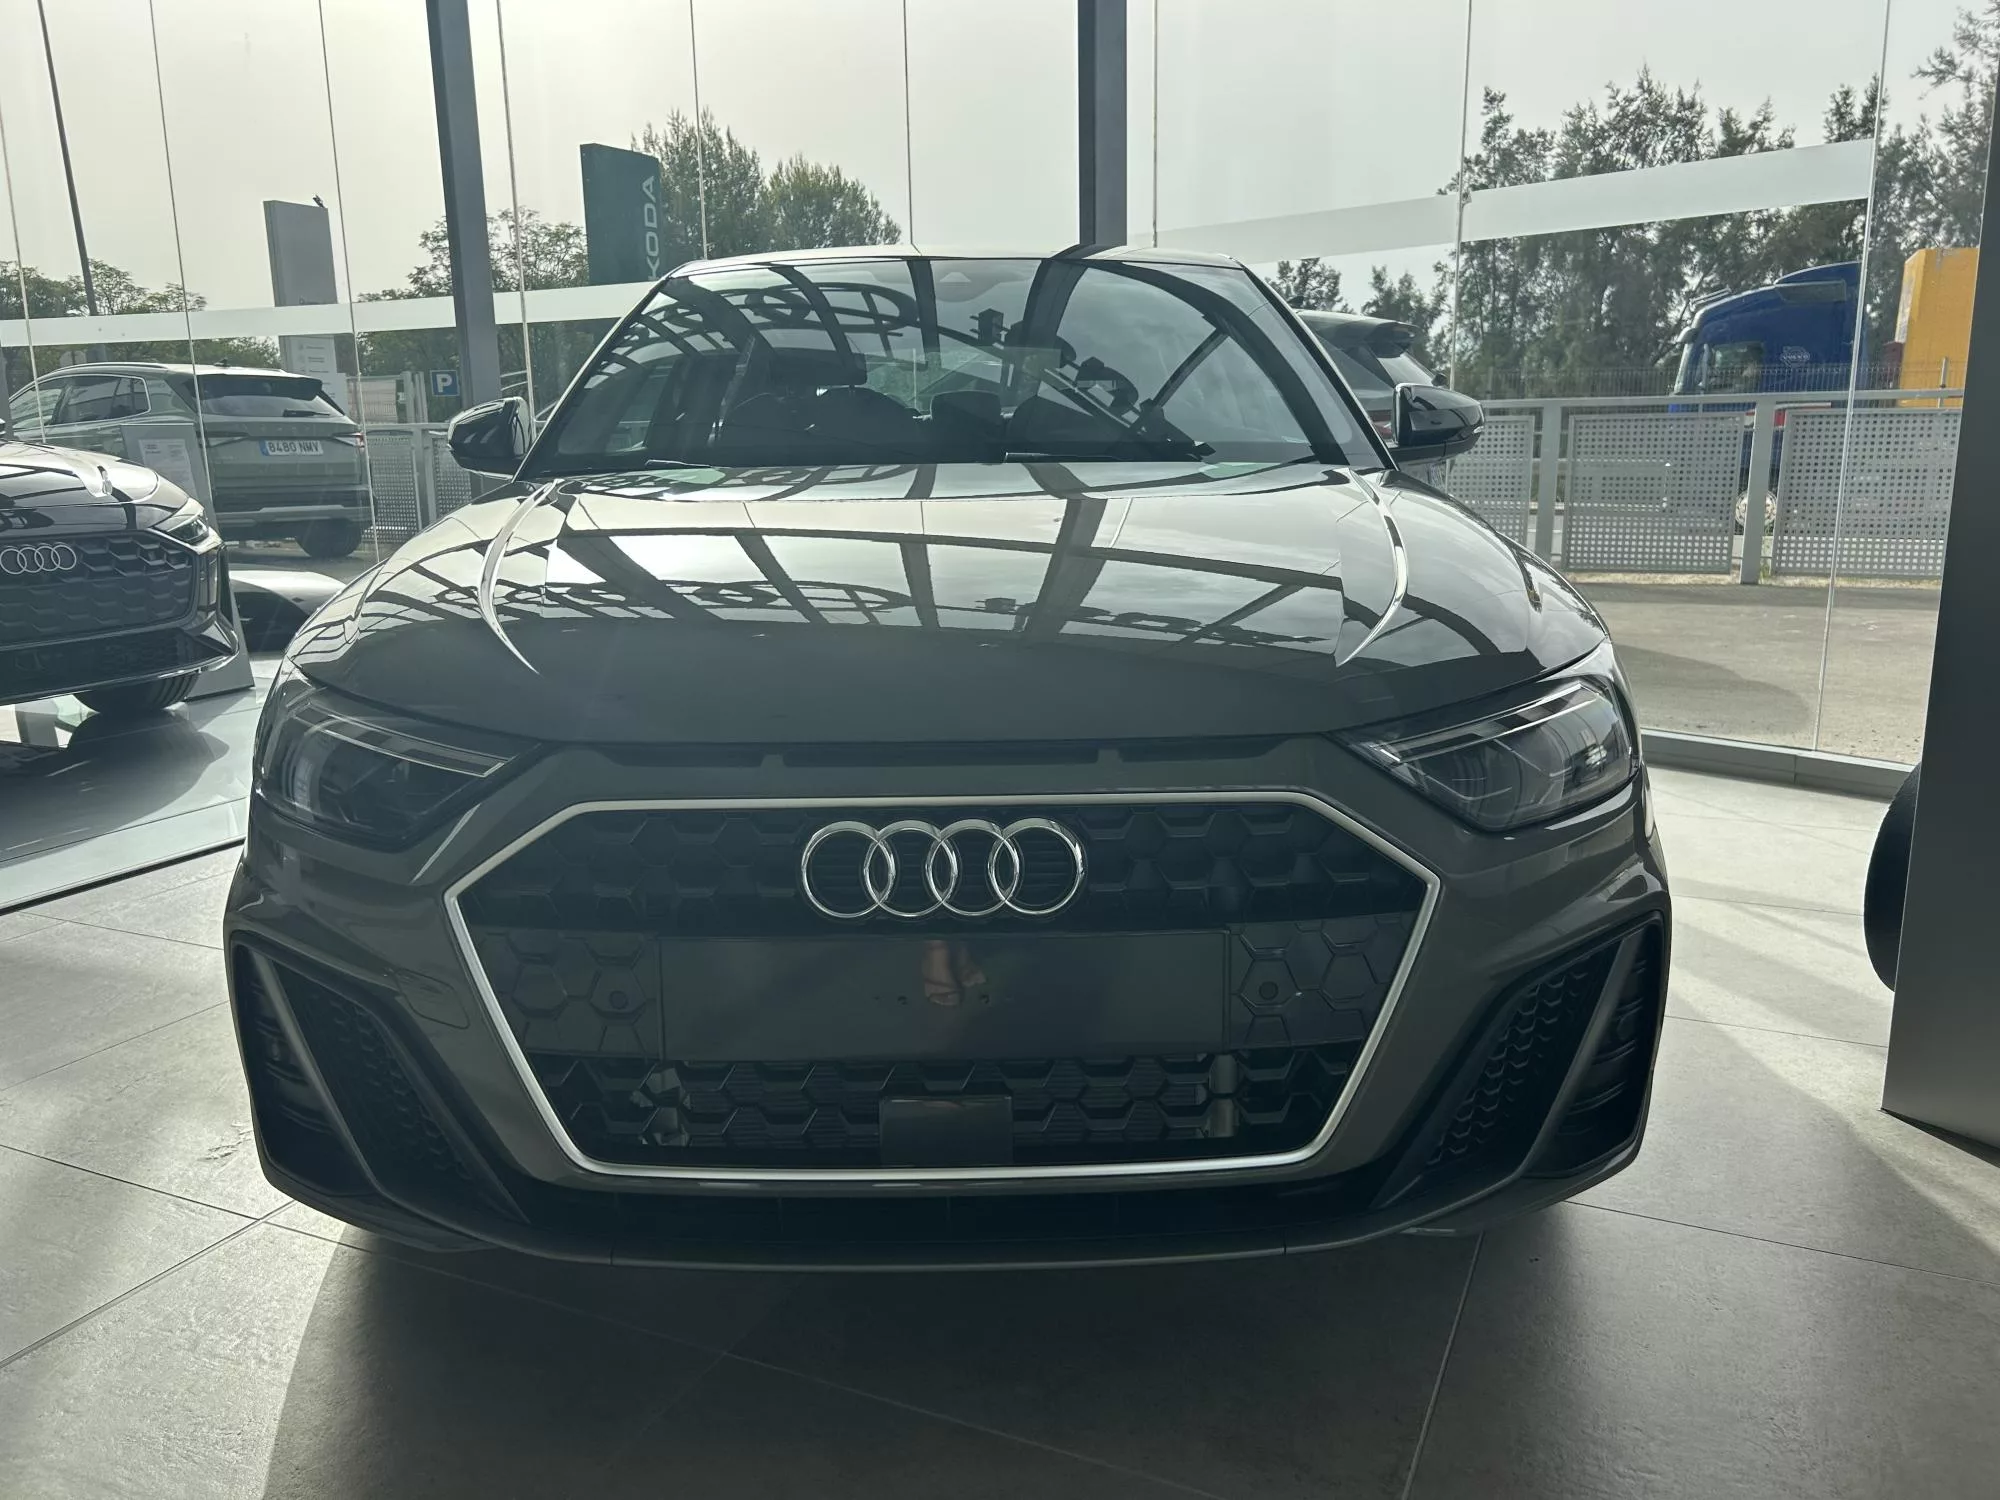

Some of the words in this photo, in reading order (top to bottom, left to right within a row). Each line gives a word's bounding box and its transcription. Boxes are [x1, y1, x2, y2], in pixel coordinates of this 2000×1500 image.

[642, 175, 661, 281] KODA
[436, 373, 452, 393] P
[268, 442, 297, 453] 8480
